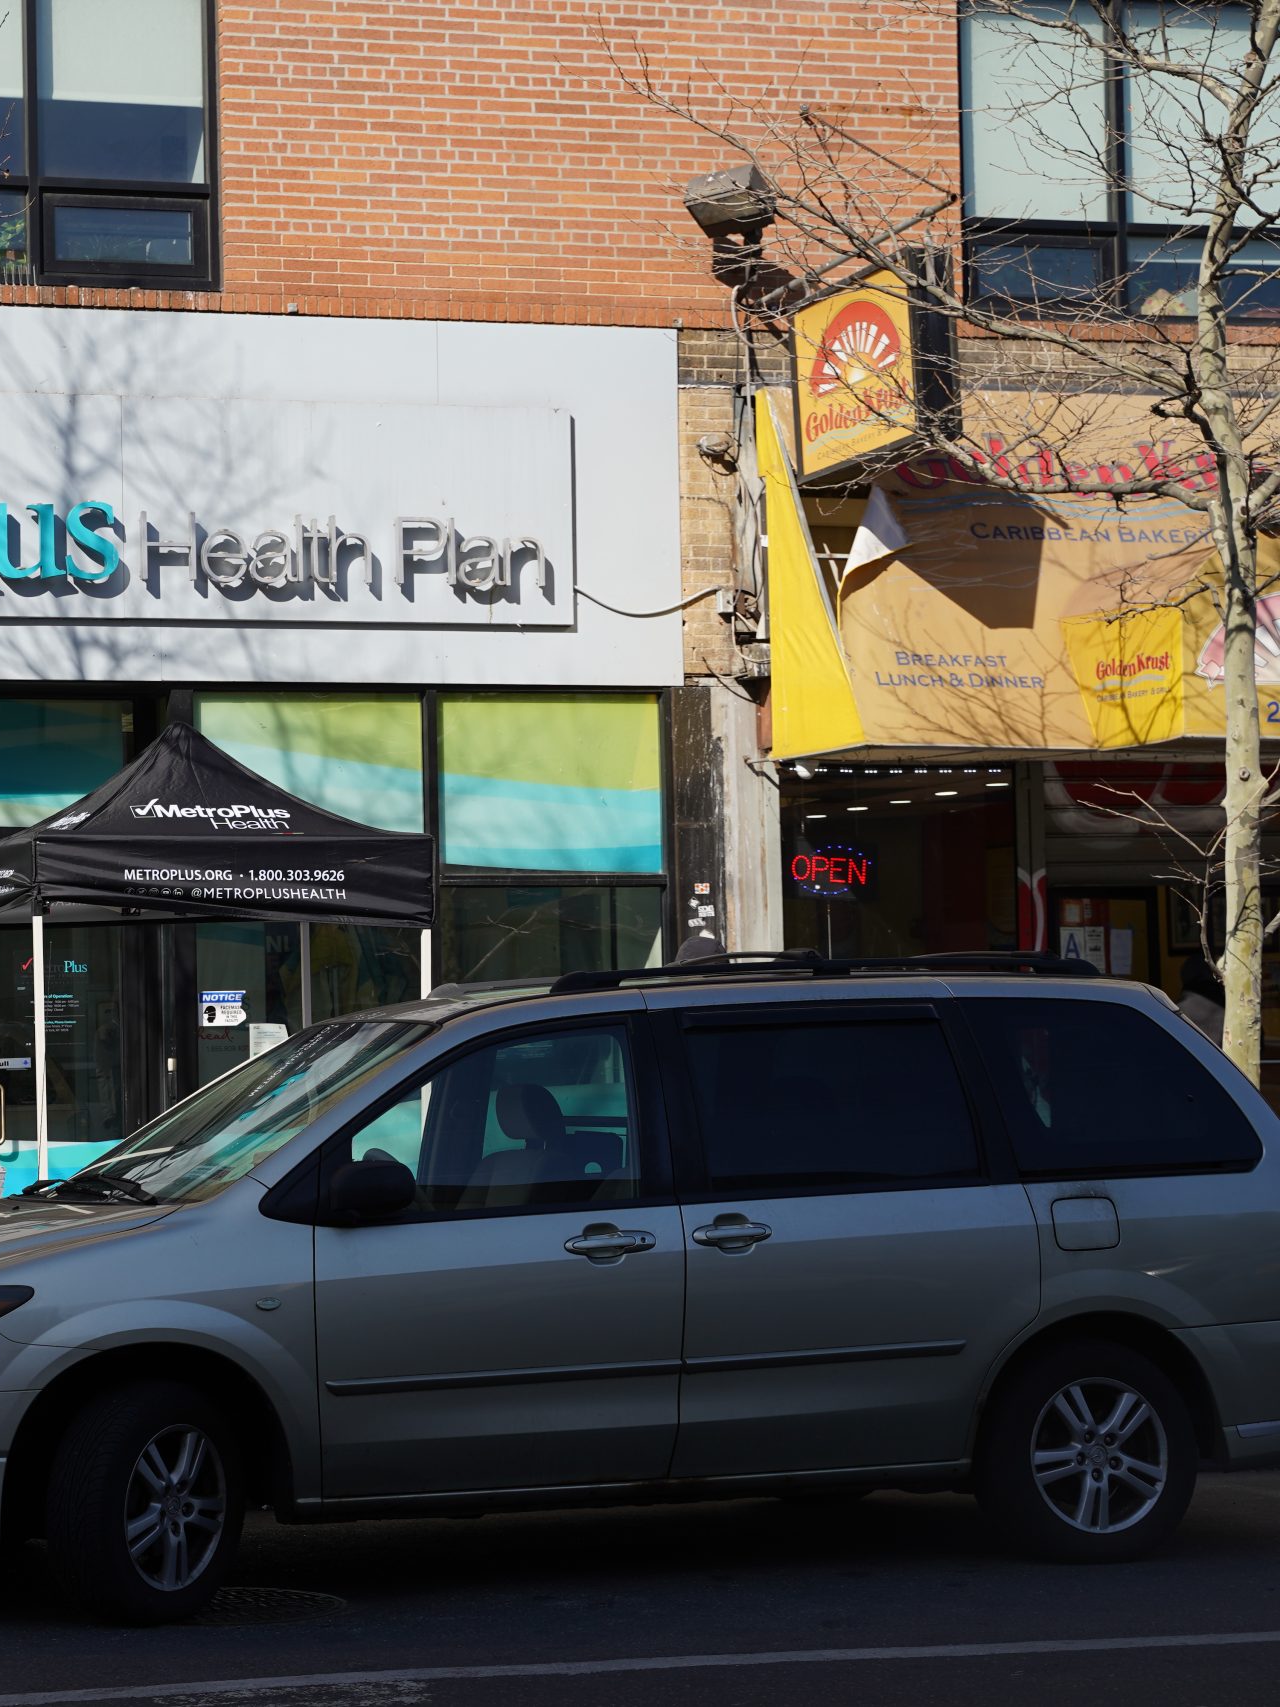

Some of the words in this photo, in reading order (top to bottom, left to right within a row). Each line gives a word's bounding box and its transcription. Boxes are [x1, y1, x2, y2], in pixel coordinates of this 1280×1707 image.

[969, 523, 1111, 543] CARIBBEAN
[140, 511, 372, 586] Health
[394, 515, 546, 588] Plan
[895, 651, 1008, 667] BREAKFAST
[875, 671, 944, 688] LUNCH
[949, 672, 964, 688] &
[968, 673, 1045, 689] DINNER
[153, 804, 291, 819] MetroPlus
[209, 817, 290, 830] Health
[124, 868, 233, 881] METROPLUS.ORG
[248, 869, 345, 882] 1.800.303.9626
[791, 855, 867, 885] OPEN
[190, 887, 346, 900] @METROPLUSHEALTH
[202, 993, 243, 1002] NOTICE
